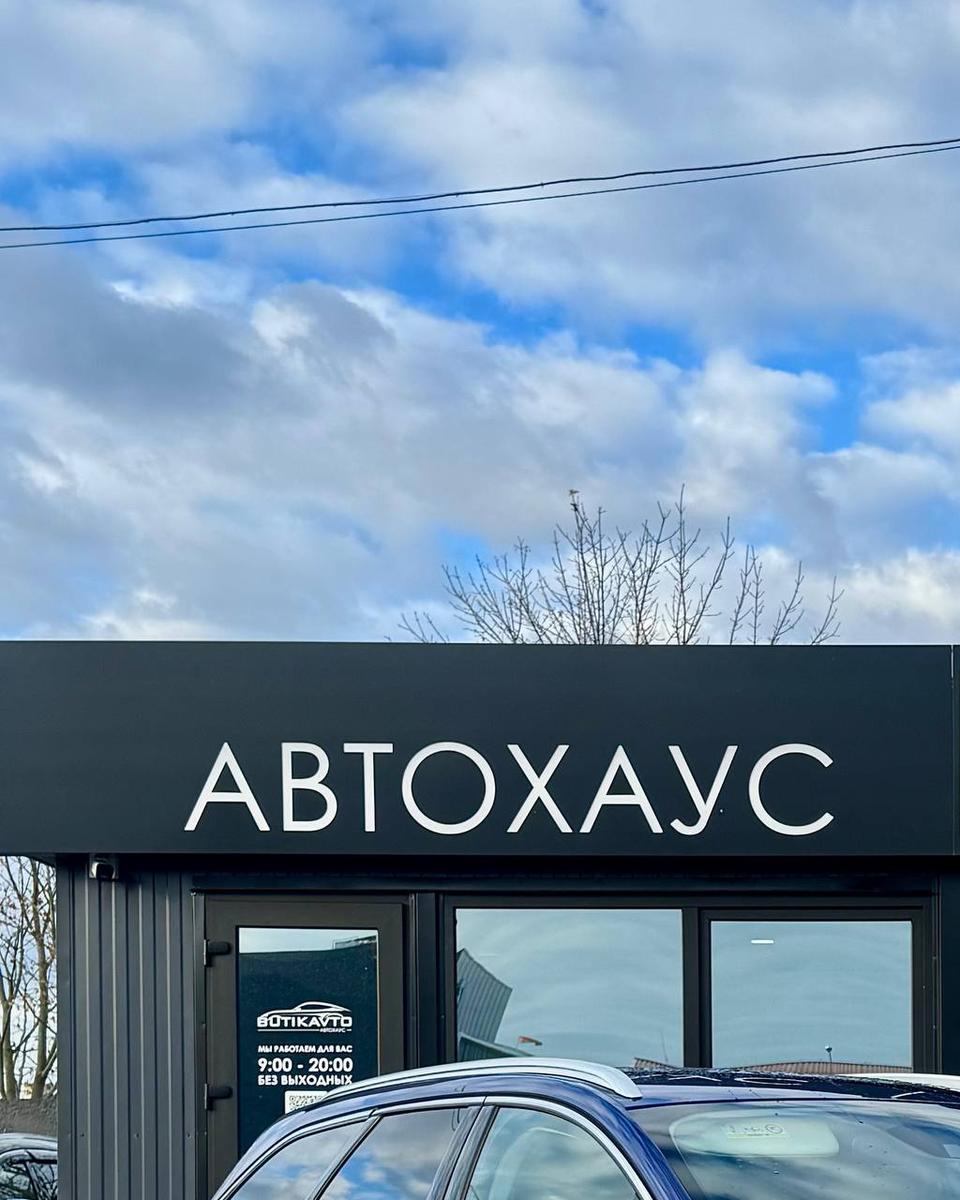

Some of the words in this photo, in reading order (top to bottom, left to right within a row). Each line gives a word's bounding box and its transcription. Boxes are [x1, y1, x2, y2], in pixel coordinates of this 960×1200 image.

[184, 741, 835, 837] АВТОХАУС
[257, 1015, 353, 1027] BUTIKAVTO
[257, 1045, 273, 1053] МЫ
[273, 1045, 316, 1053] РАБОТАЕМ
[316, 1045, 335, 1054] ДЛЯ
[335, 1045, 353, 1053] ВАС
[257, 1057, 293, 1073] 9:00
[308, 1057, 354, 1073] 20:00
[257, 1074, 278, 1086] БЕЗ
[281, 1074, 353, 1086] ВЫХОДНЫХ
